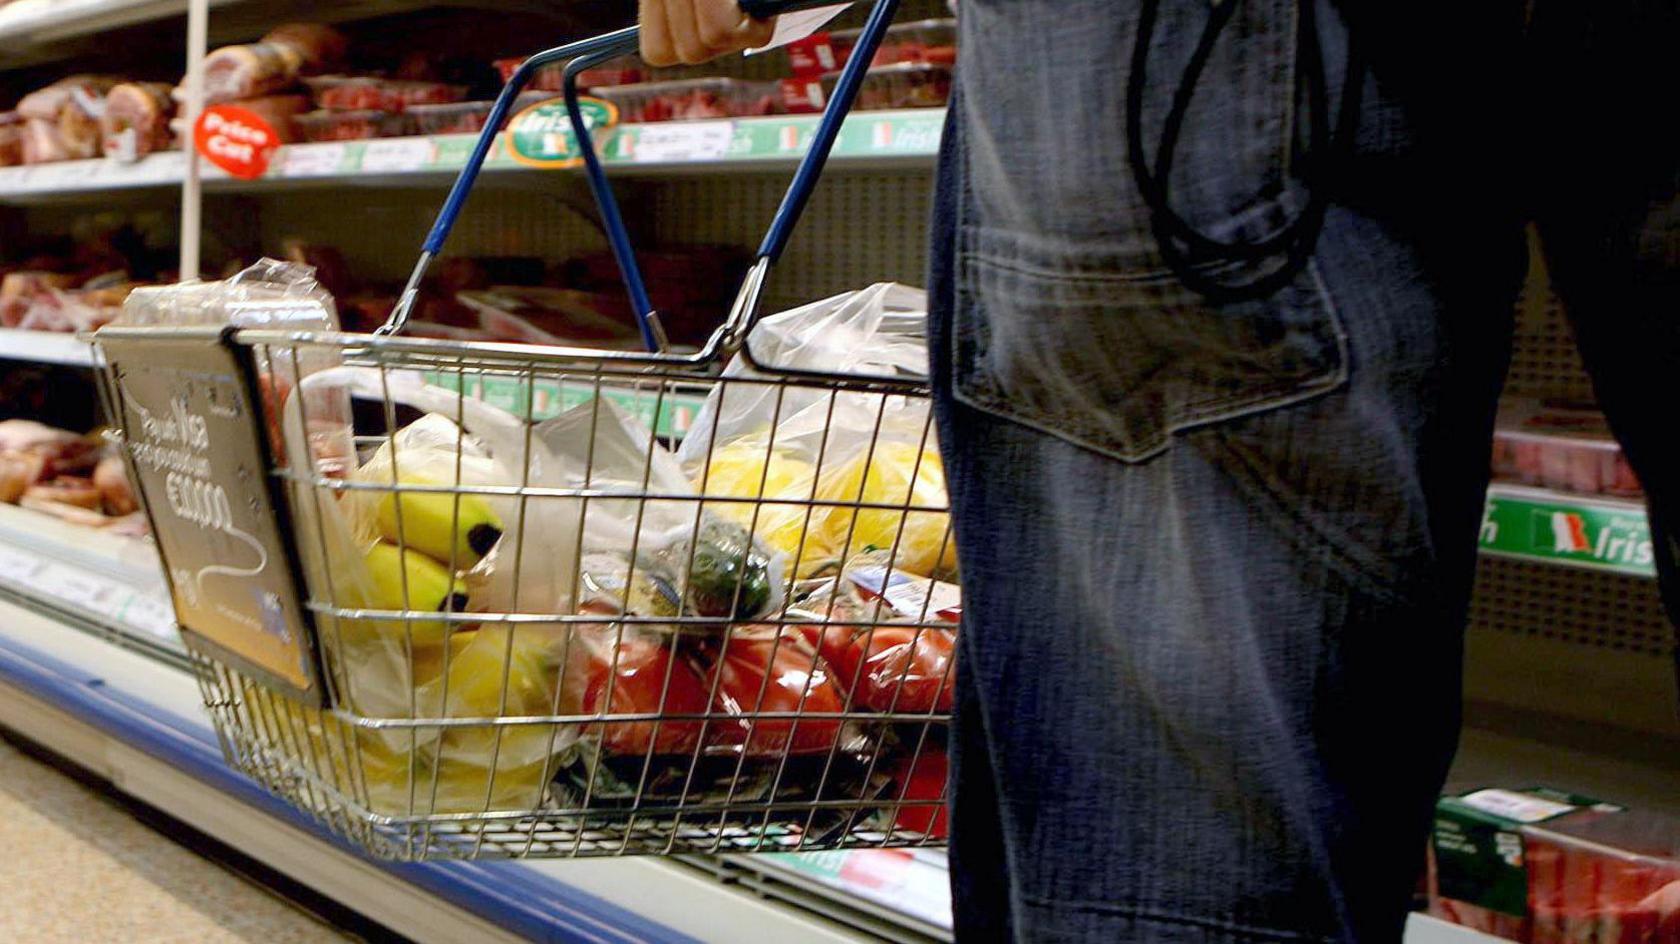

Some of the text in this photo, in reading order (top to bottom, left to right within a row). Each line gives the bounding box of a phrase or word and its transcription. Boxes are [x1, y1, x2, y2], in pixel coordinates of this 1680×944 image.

[204, 112, 268, 145] Price
[207, 134, 254, 163] Cut
[1594, 526, 1654, 565] Iris
